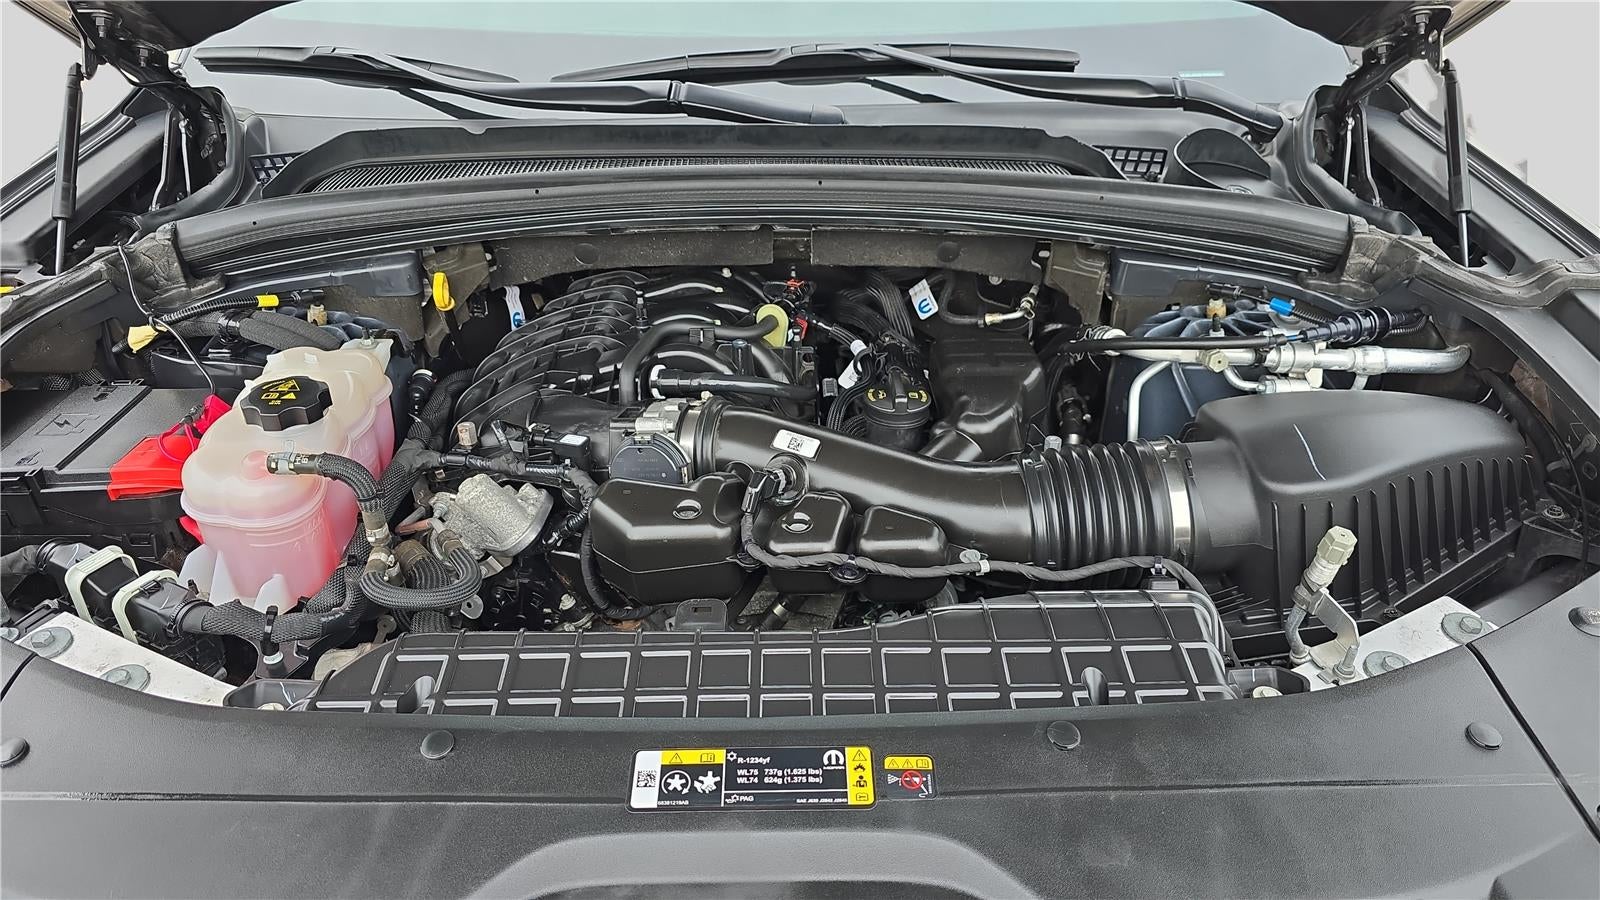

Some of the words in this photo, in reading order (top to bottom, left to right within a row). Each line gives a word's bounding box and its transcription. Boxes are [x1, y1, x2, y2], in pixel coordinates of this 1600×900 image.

[737, 757, 771, 765] R-1234yf
[764, 768, 782, 777] 737g
[784, 768, 807, 777] (1.625
[808, 768, 823, 776] lbs)
[764, 776, 783, 785] 624g
[784, 776, 807, 785] (1.375
[808, 776, 823, 784] lbs)
